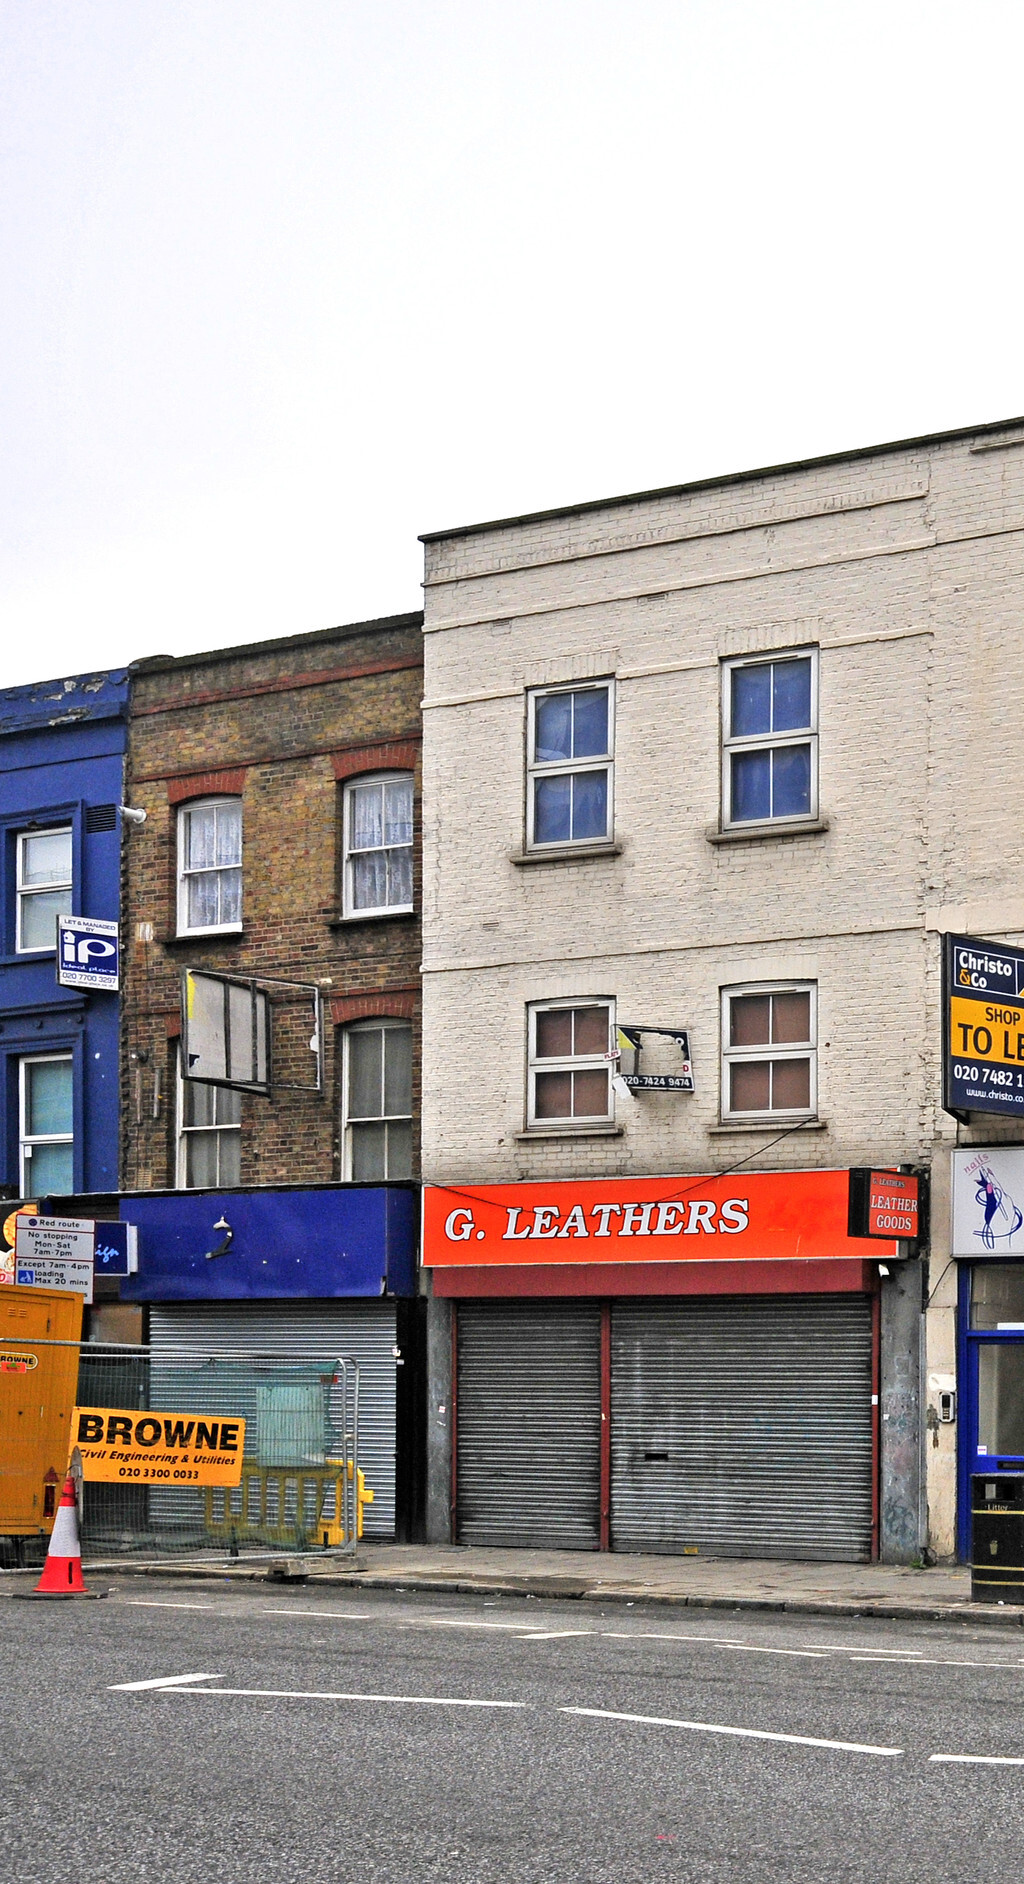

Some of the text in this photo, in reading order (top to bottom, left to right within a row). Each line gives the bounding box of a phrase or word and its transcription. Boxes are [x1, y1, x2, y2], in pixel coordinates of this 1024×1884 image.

[83, 921, 116, 930] MANAGED
[959, 951, 1013, 977] Christo
[78, 974, 97, 982] 7700
[959, 969, 987, 988] &Co
[985, 1006, 1021, 1026] SHOP
[957, 1022, 993, 1055] TO
[954, 1064, 979, 1081] 020
[982, 1068, 1013, 1086] 7482
[623, 1076, 690, 1087] 020-7424 9474
[870, 1194, 918, 1212] LEATHER
[39, 1219, 80, 1229] Red route
[444, 1198, 750, 1241] G. LEATHERS
[876, 1214, 912, 1231] GOODS
[28, 1231, 78, 1241] No stopping
[34, 1241, 71, 1249] Mon-Sat
[33, 1248, 72, 1257] 7am-7pm
[17, 1260, 46, 1269] Except
[34, 1269, 65, 1279] loading
[34, 1277, 52, 1285] Max
[69, 1279, 89, 1287] mins
[77, 1413, 240, 1451] BROWNE
[80, 1449, 236, 1466] Civil Engineering & Utilities
[118, 1467, 199, 1480] 020 3300 0033
[987, 1503, 1009, 1511] Litter
